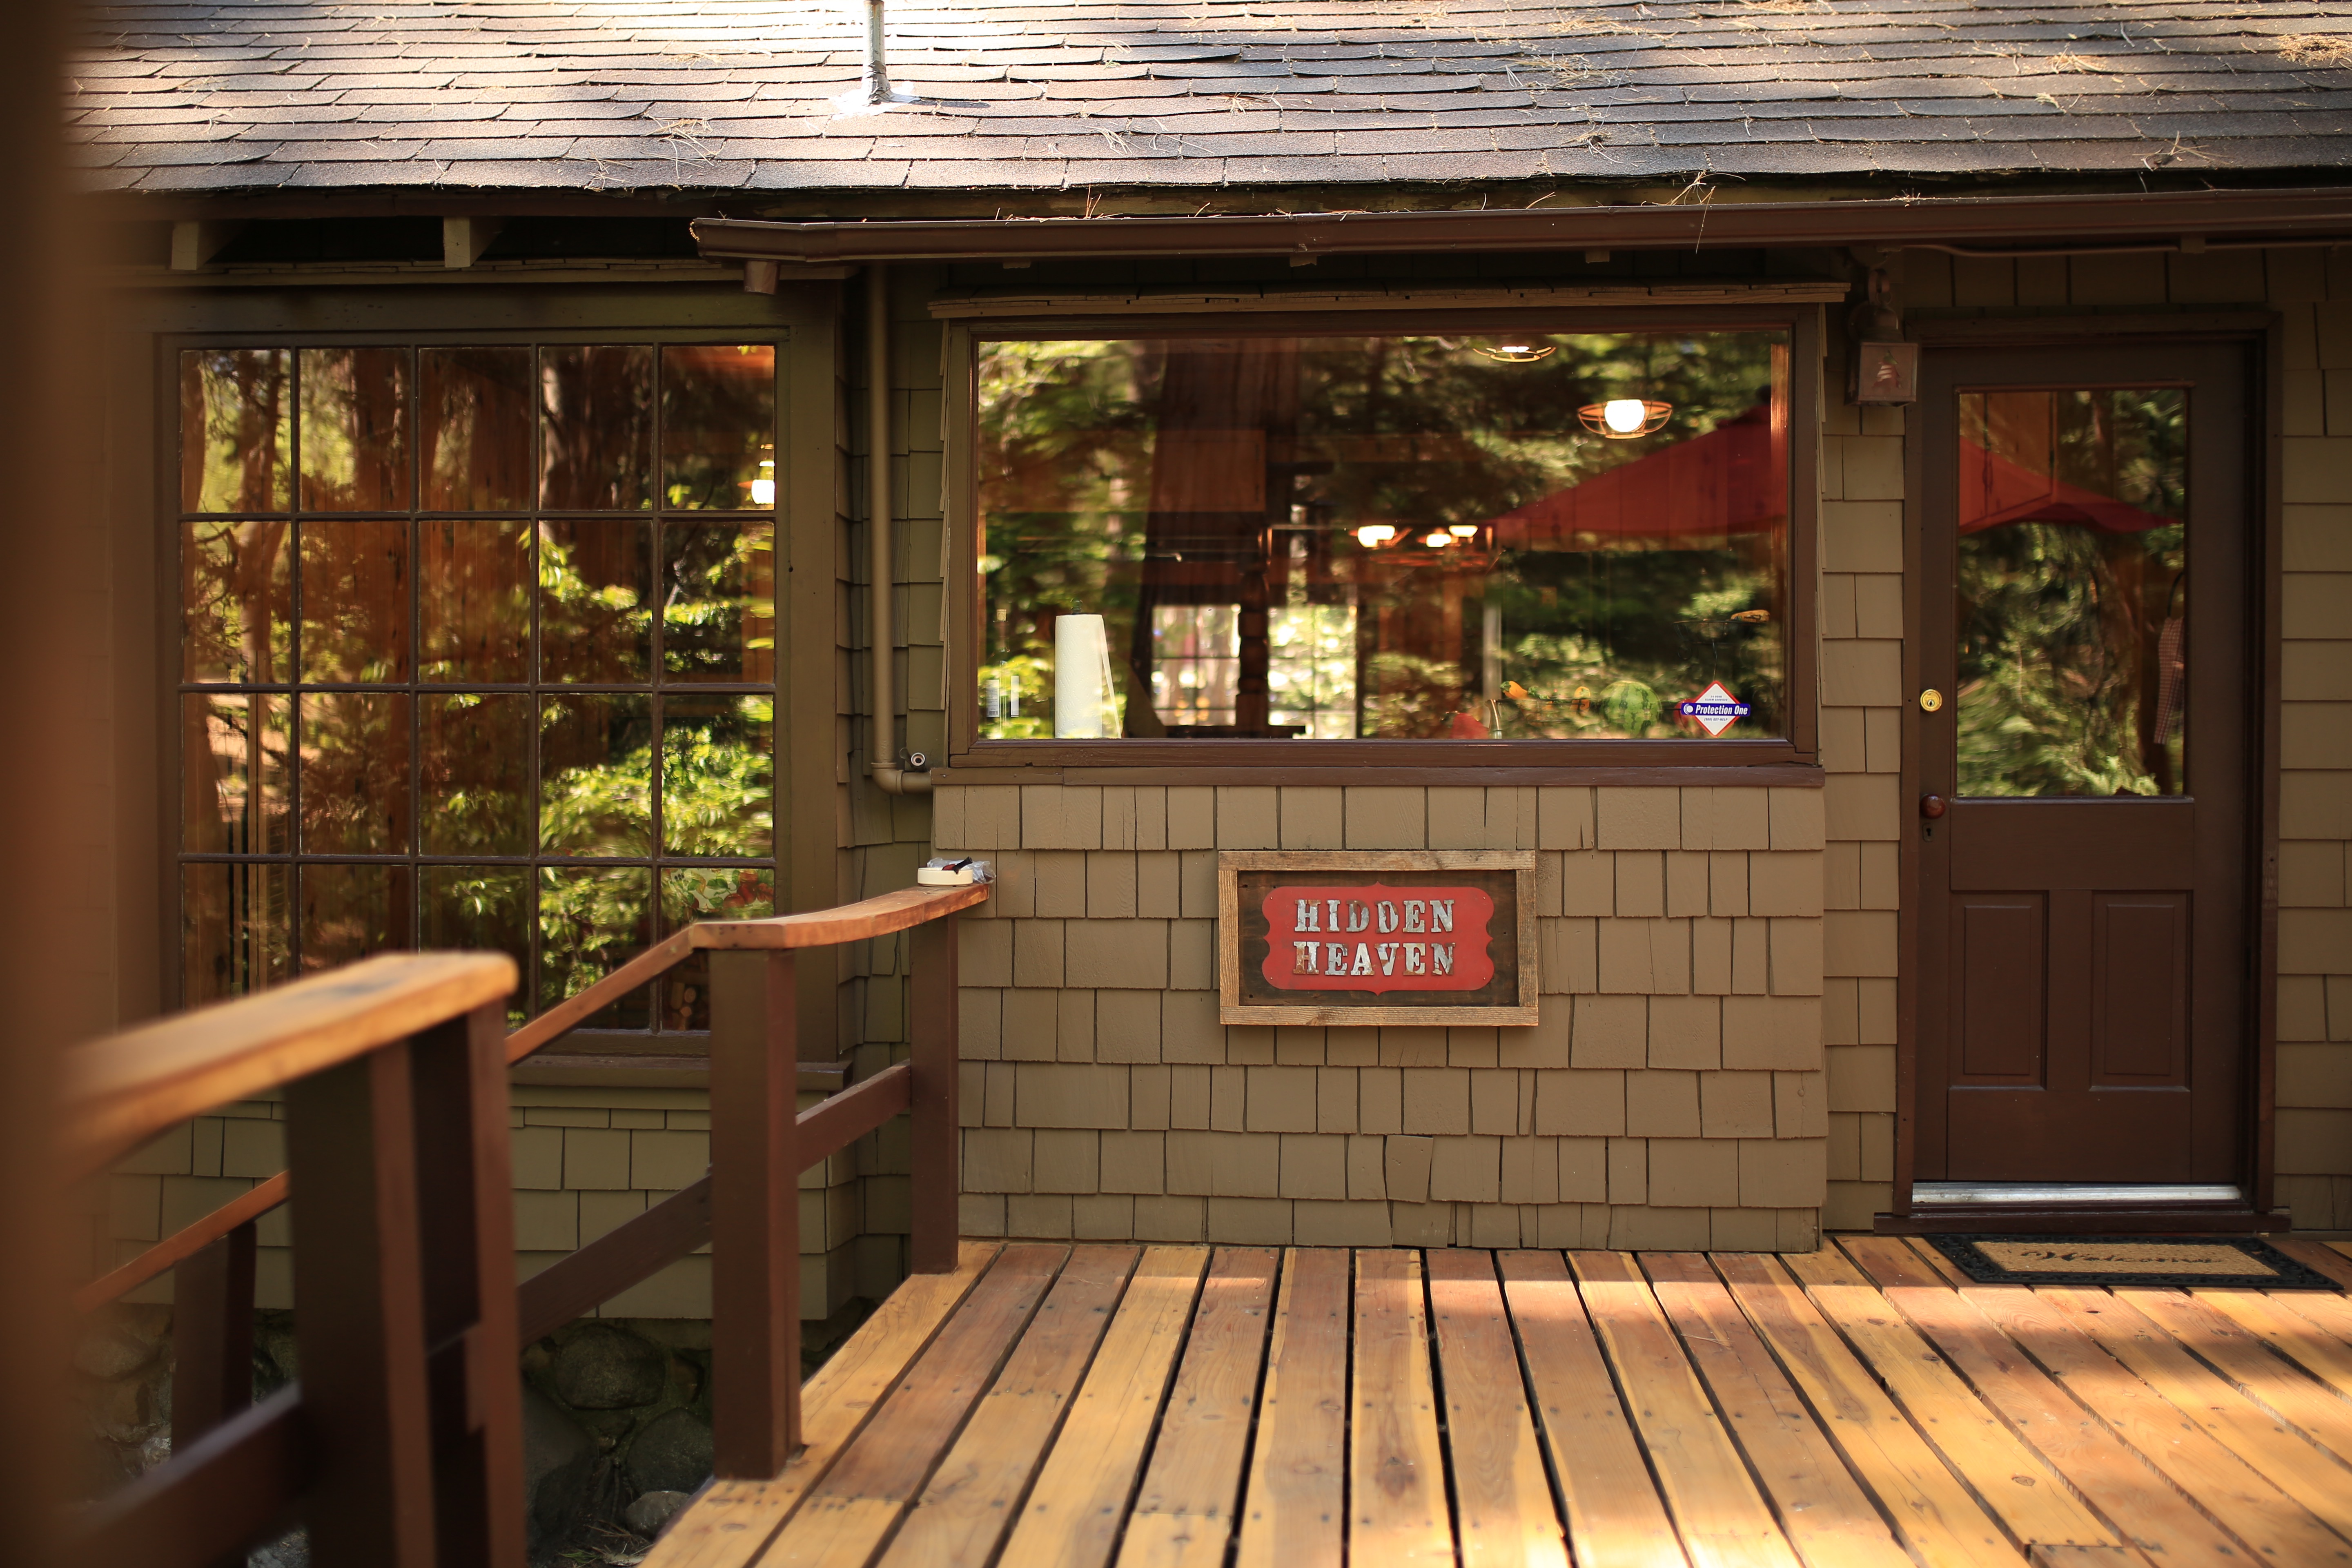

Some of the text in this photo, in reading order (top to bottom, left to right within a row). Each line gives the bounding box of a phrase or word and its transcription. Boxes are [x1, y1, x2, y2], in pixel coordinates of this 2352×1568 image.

[1695, 704, 1748, 715] Protection One
[1294, 899, 1454, 934] HIDDEN
[1293, 941, 1456, 976] HEAVEN
